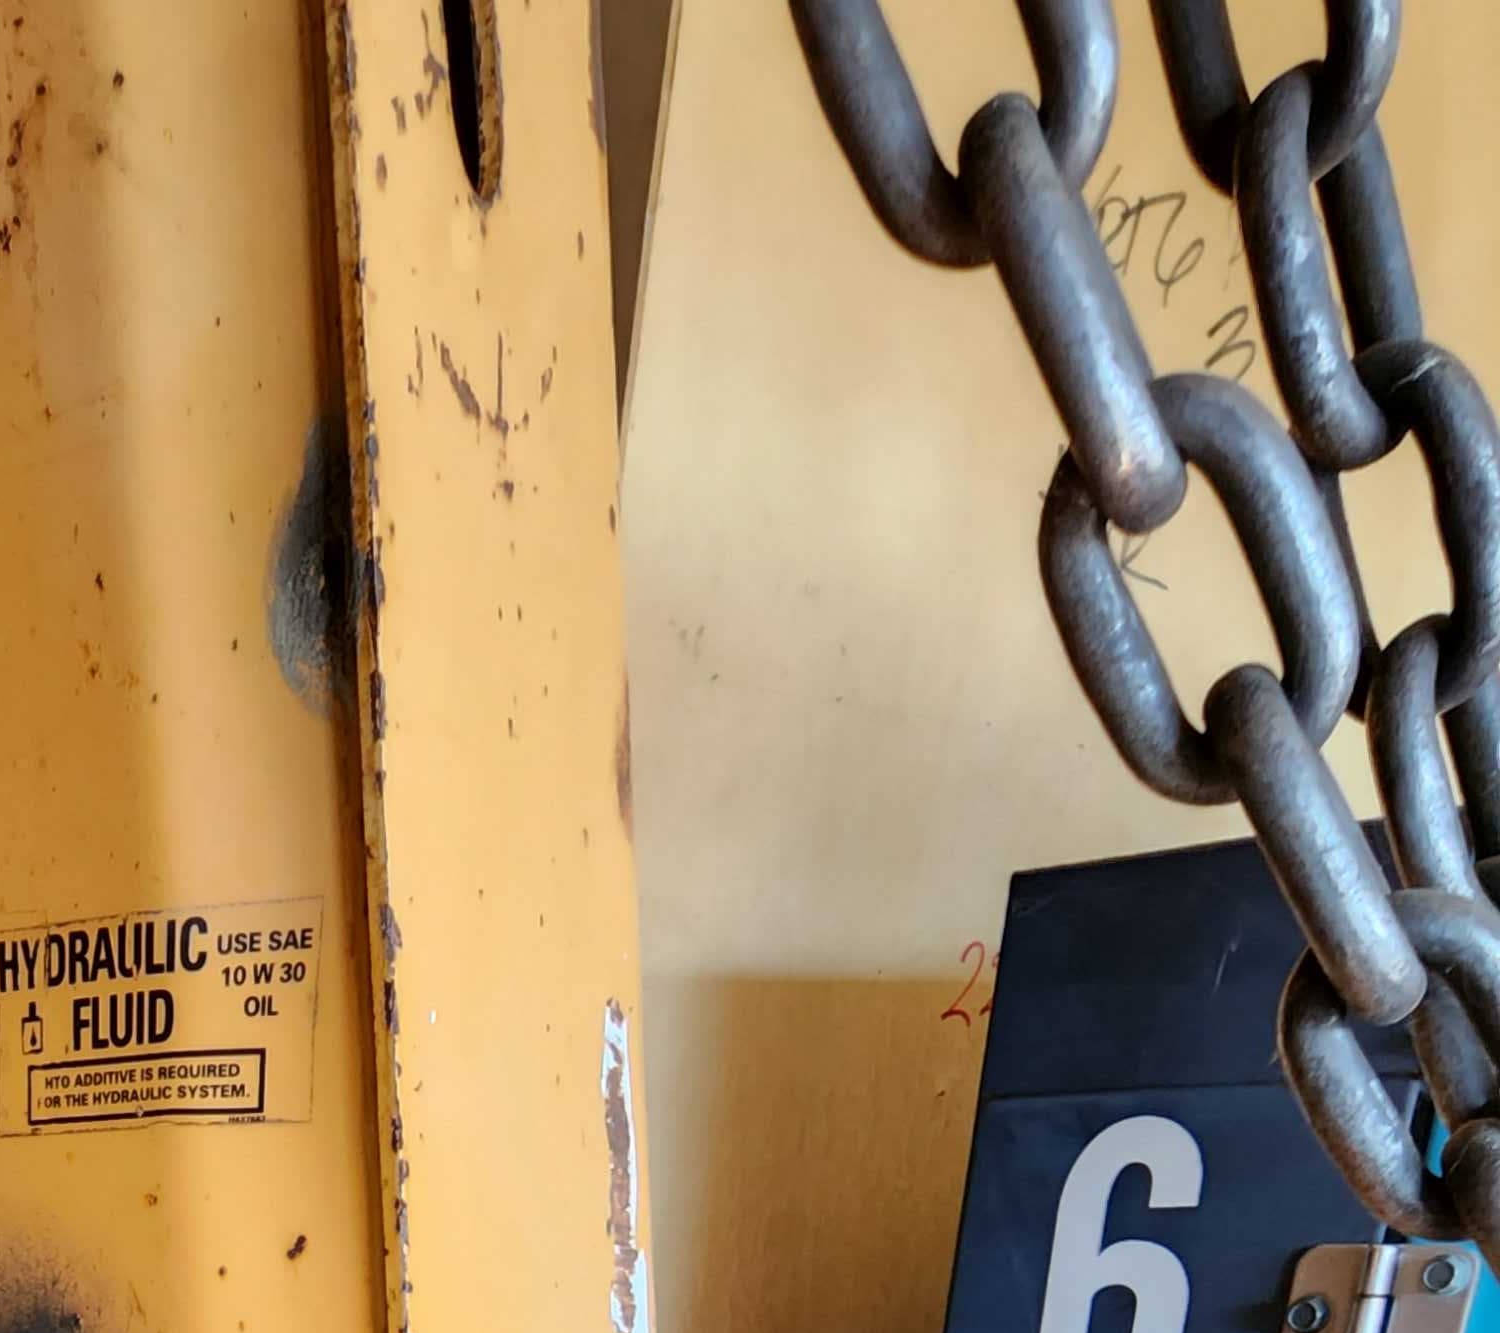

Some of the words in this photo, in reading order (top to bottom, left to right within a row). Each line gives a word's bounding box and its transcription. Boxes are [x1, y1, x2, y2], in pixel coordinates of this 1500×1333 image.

[217, 931, 263, 955] USE
[268, 928, 314, 951] SAE
[221, 965, 247, 987] 10
[253, 963, 274, 984] W
[279, 961, 306, 983] 30
[243, 995, 279, 1018] OIL
[72, 989, 175, 1052] FLUID
[75, 1069, 137, 1088] ADDITIVE
[141, 1067, 154, 1082] IS
[158, 1063, 241, 1081] REQUIRED
[65, 1092, 90, 1107] THE
[93, 1087, 172, 1105] HYDRAULIC
[177, 1083, 251, 1101] SYSTEM.
